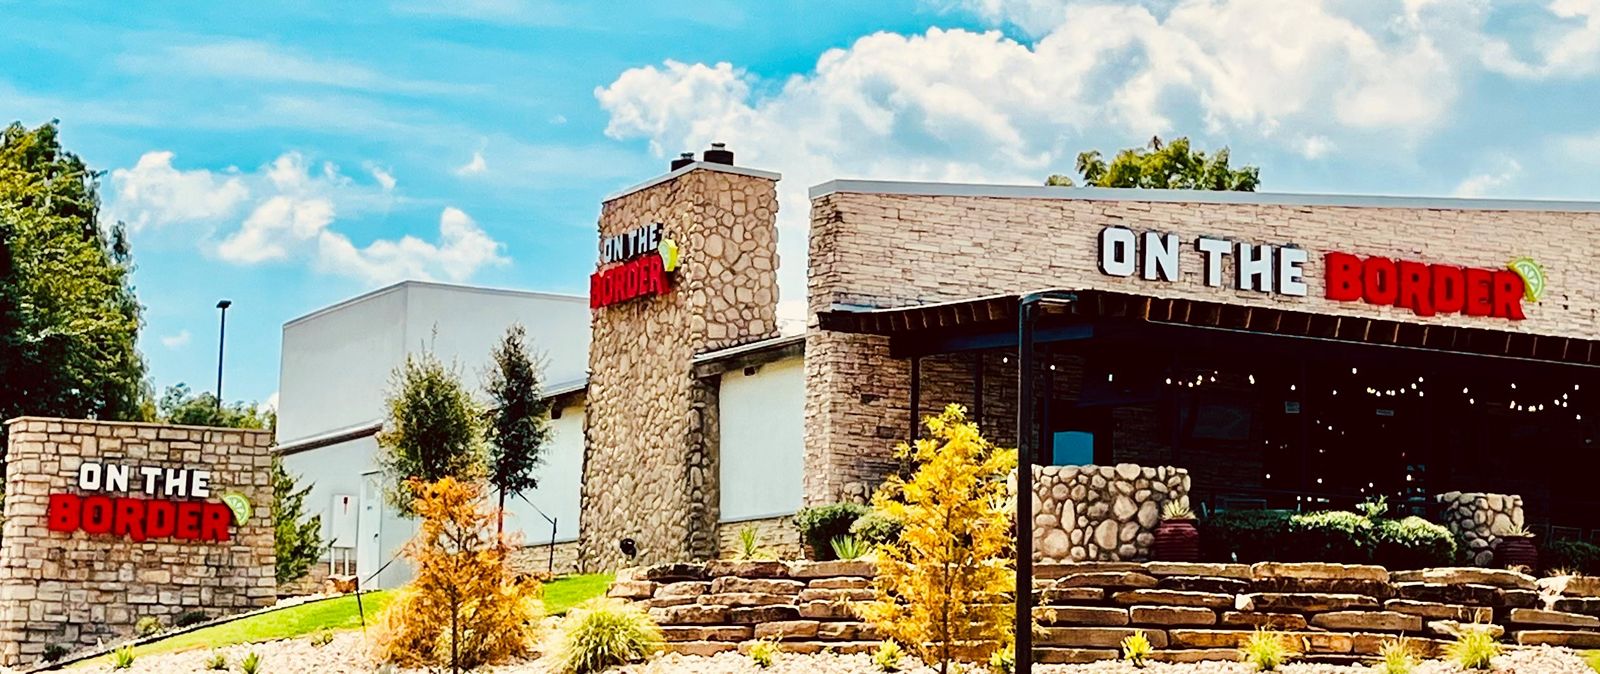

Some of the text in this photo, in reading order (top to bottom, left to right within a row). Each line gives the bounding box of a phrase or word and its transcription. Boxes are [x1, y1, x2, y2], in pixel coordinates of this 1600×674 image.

[603, 223, 658, 264] ON THE
[590, 254, 668, 309] BORDER
[1101, 226, 1527, 321] ON THE BORDER
[79, 462, 211, 498] ON THE
[49, 493, 232, 542] BORDER
